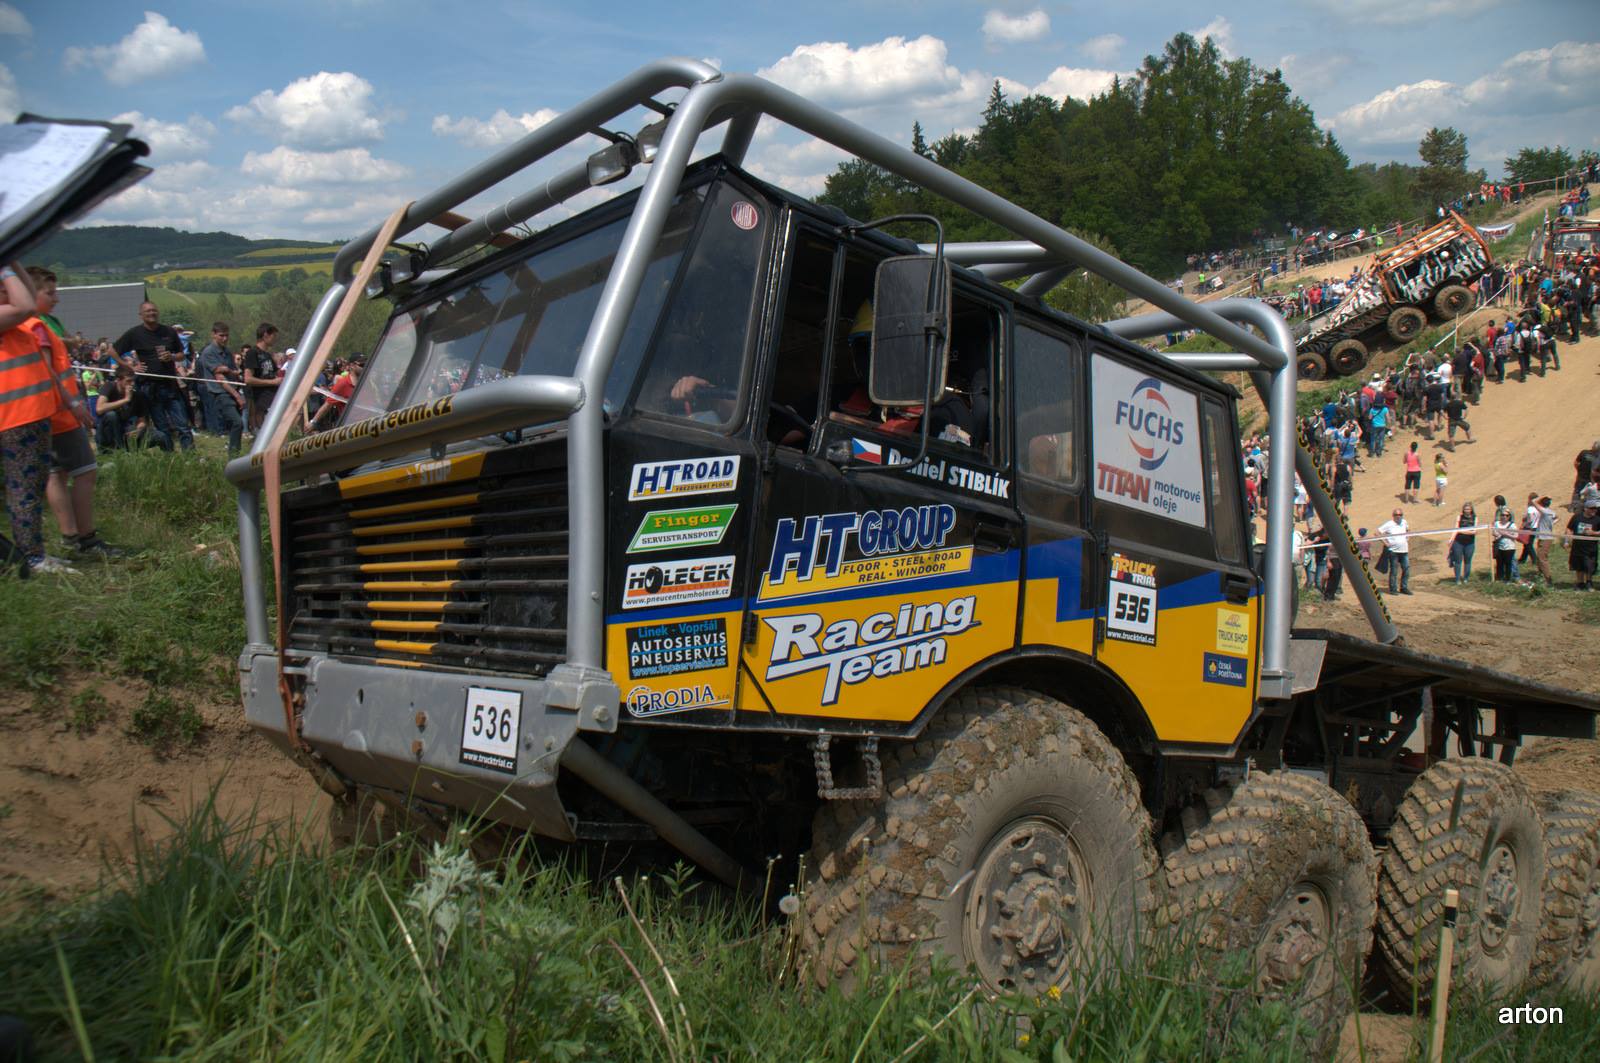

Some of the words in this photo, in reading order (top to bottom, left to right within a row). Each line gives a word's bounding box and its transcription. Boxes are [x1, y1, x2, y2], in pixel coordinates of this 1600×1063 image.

[1115, 400, 1184, 445] FUCHS
[681, 459, 734, 480] ROAD
[948, 465, 1010, 499] STIBLÍK
[1097, 462, 1151, 504] TITAN
[1154, 479, 1201, 503] motorové
[1153, 496, 1177, 513] oleje
[654, 513, 720, 528] Finger
[858, 504, 957, 557] GROUP
[641, 530, 719, 545] SERVISTRANSPORT
[842, 561, 881, 574] FLOOR
[892, 557, 925, 568] STEEL
[934, 551, 962, 562] ROAD
[858, 572, 886, 583] REAL
[896, 563, 946, 577] WINDOOR
[1111, 555, 1157, 577] TRUCK
[1131, 572, 1157, 588] TRIAL
[625, 588, 729, 606] www.pneucentrumholecek.cz
[1114, 592, 1151, 624] 536
[637, 625, 668, 638] Linek
[678, 620, 717, 635] Vopršál
[761, 595, 982, 662] Racing
[1218, 629, 1233, 641] TRUCK
[1234, 632, 1248, 643] SHOP
[631, 632, 726, 653] AUTOSERVIS
[631, 645, 727, 667] PNEUSERVIS
[766, 637, 947, 706] Team
[636, 684, 714, 712] PRODIA
[472, 704, 512, 743] 536
